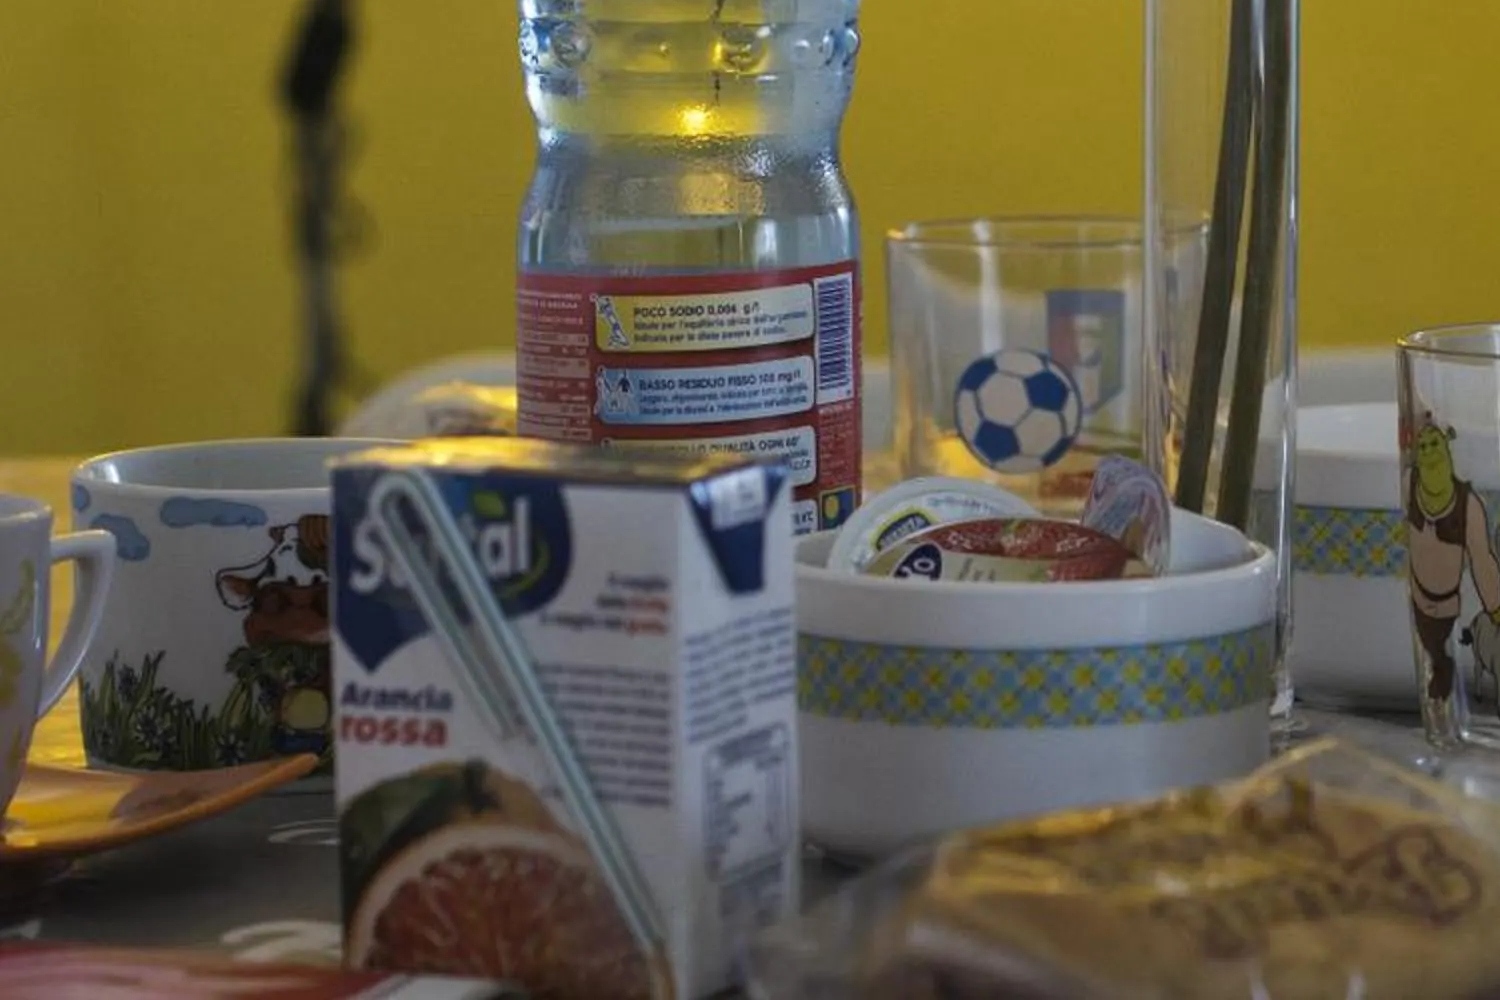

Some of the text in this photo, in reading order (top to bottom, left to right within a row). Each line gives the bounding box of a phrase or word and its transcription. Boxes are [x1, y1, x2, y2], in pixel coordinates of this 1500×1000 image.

[633, 306, 667, 318] POCO
[669, 305, 704, 317] SODIO
[638, 378, 675, 391] BASSO
[678, 376, 726, 389] RESIDUO
[340, 680, 453, 712] Arancia
[339, 714, 448, 747] rossa
